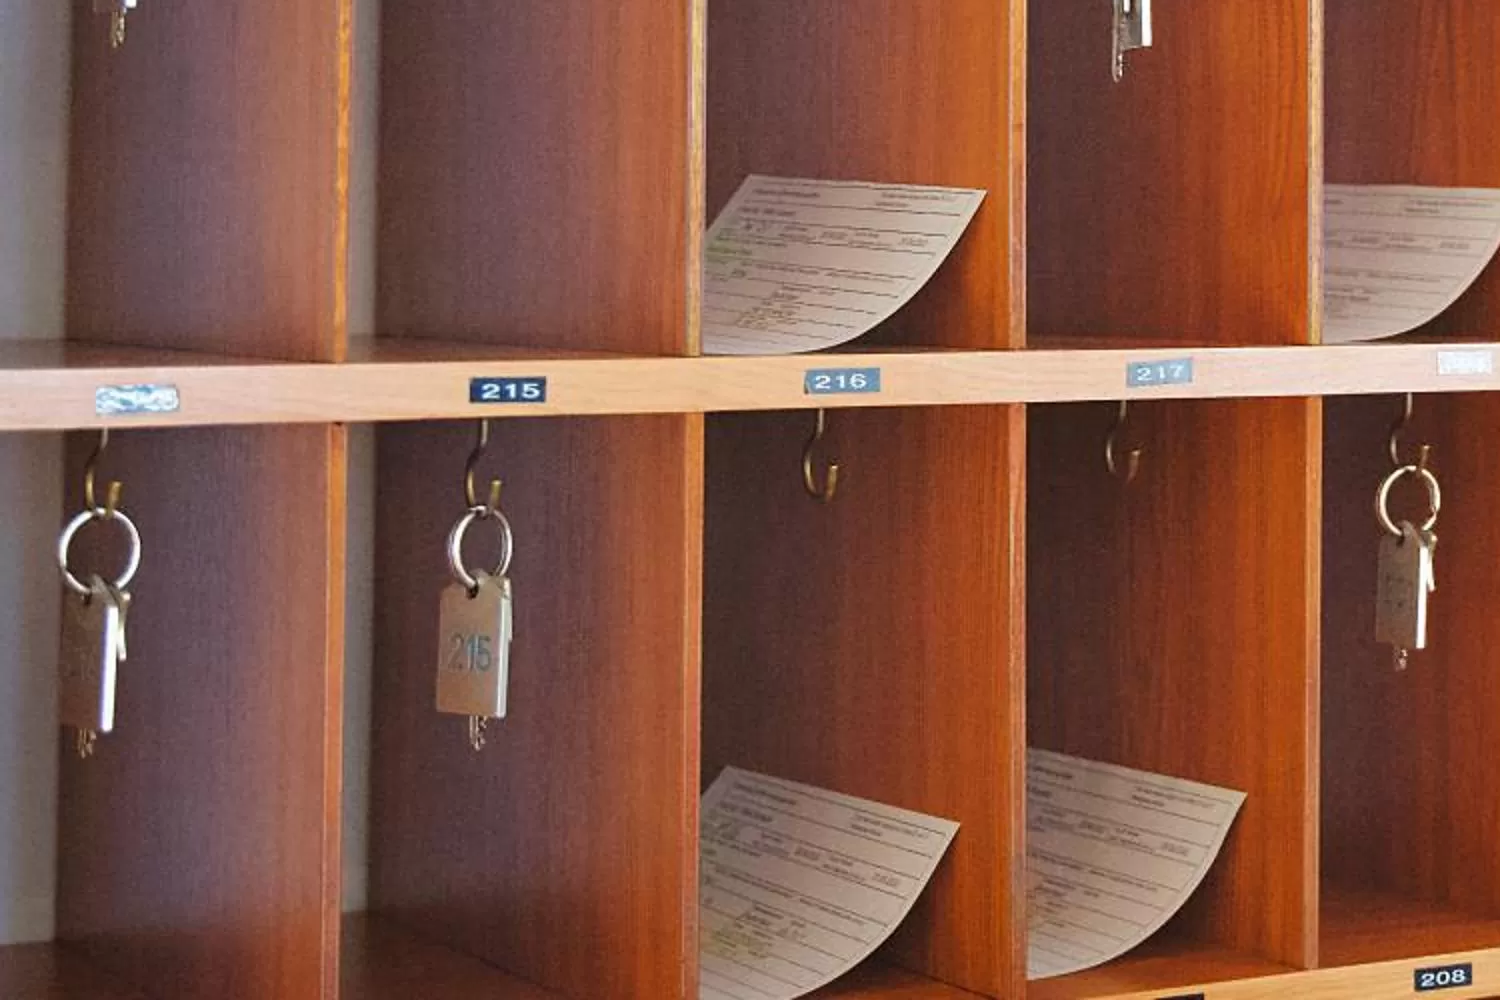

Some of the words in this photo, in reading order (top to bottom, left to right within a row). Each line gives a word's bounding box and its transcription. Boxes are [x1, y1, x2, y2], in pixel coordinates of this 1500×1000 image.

[1137, 364, 1184, 381] 217
[815, 373, 867, 390] 216
[481, 382, 540, 400] 215
[1421, 968, 1466, 987] 208
